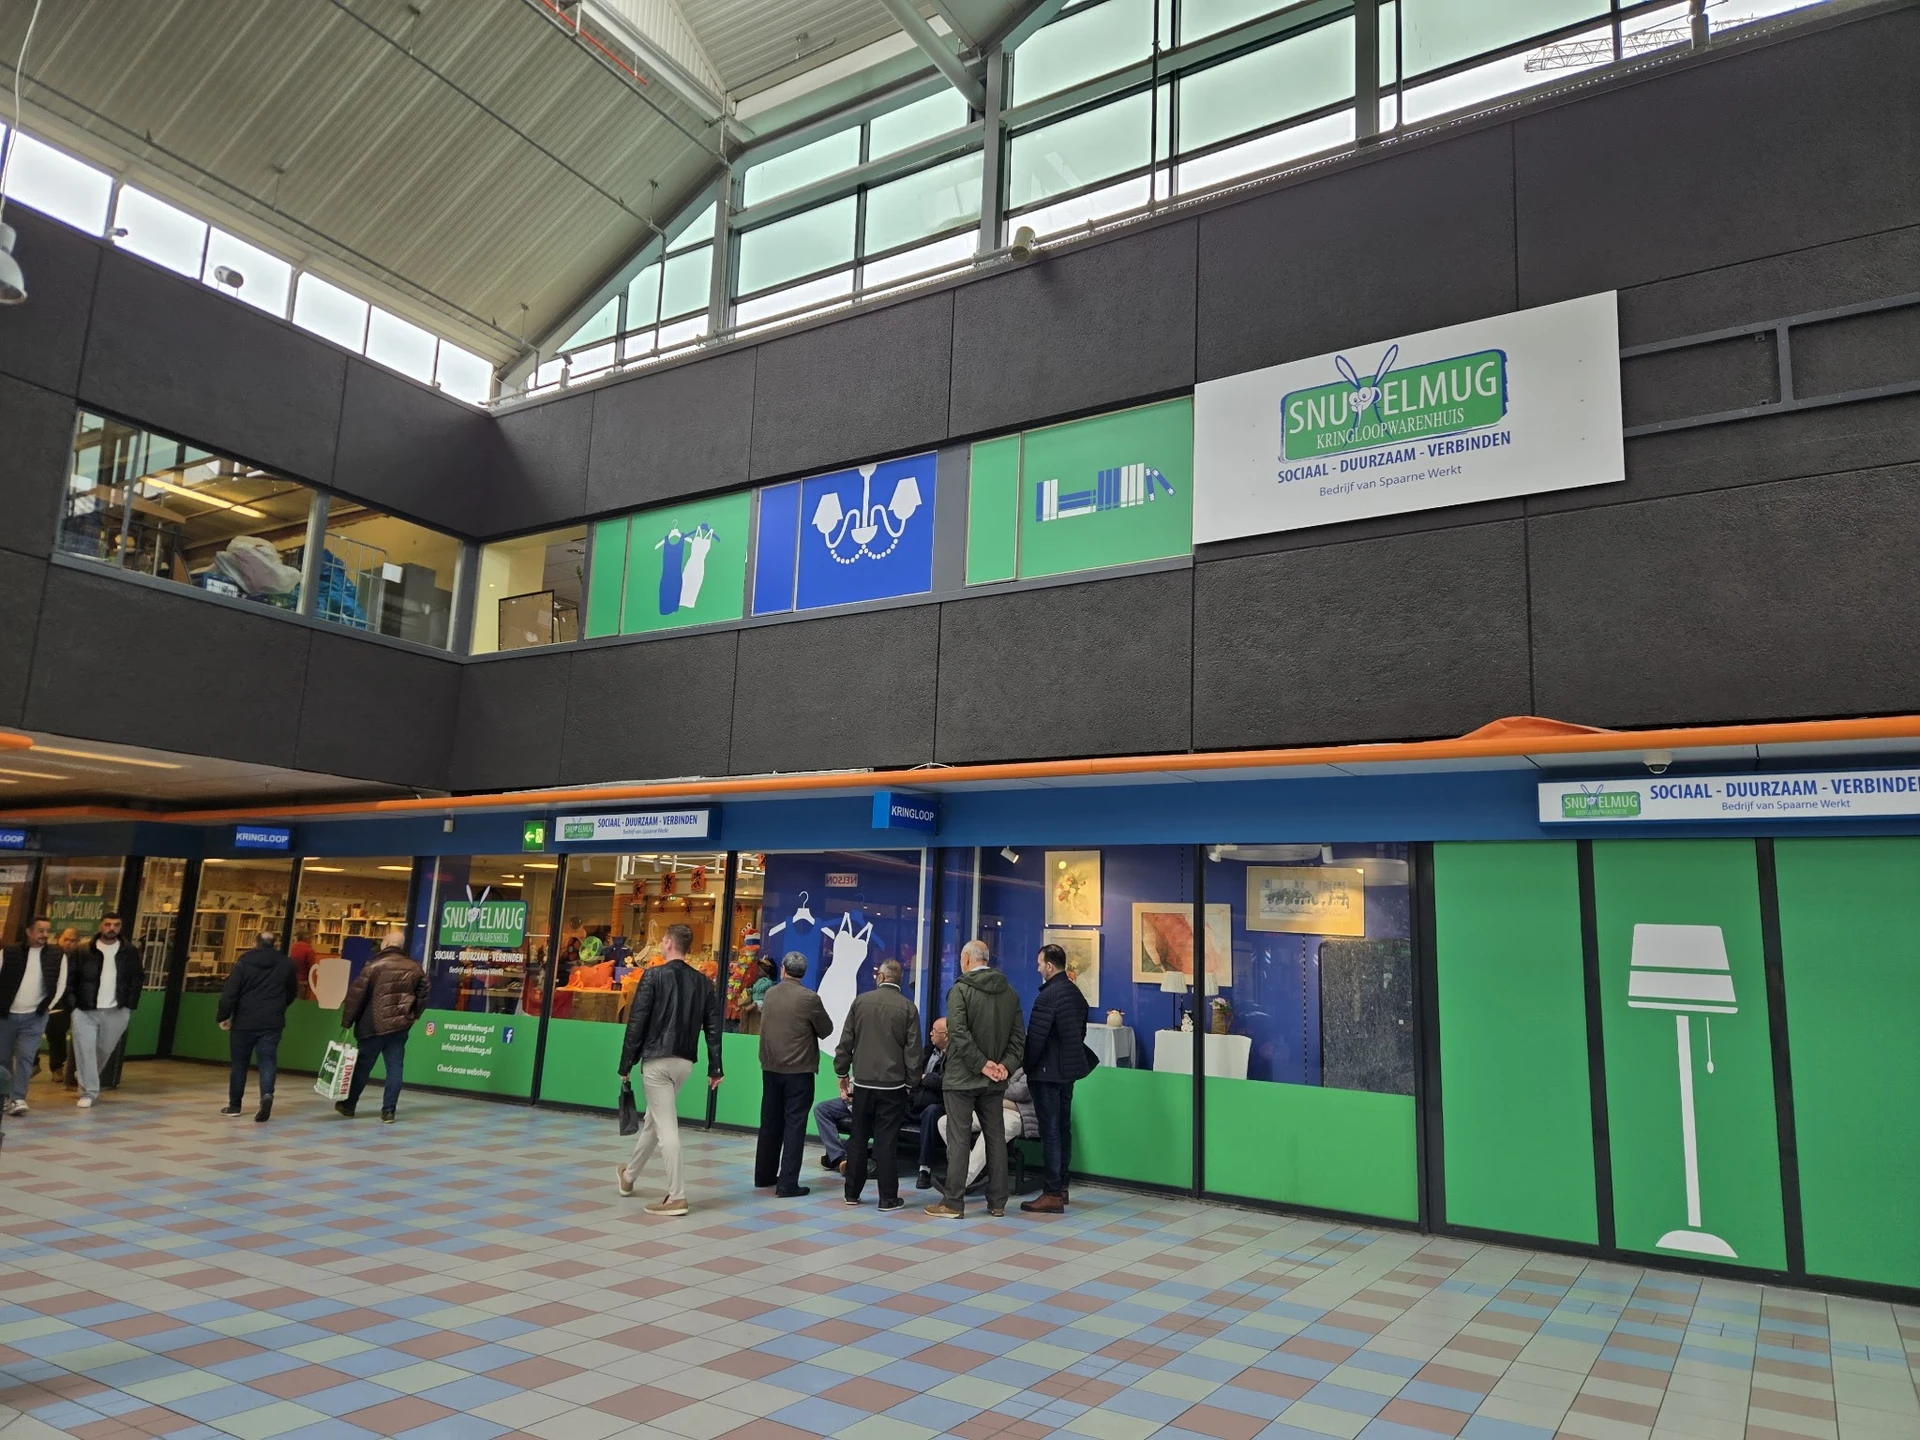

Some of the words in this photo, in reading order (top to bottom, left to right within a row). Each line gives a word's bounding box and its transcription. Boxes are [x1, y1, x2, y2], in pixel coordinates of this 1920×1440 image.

[1316, 407, 1465, 450] KRINGLOOPWARENHUIS
[1277, 461, 1329, 484] SOCIAAL
[1340, 448, 1417, 473] DUURZAAM
[1428, 431, 1512, 458] VERBINDEN
[1319, 481, 1355, 497] Bedrijf
[1357, 480, 1376, 491] van
[1379, 472, 1426, 490] Spaarne
[1428, 465, 1463, 479] Werkt
[1650, 783, 1713, 800] SOCIAAL
[1726, 779, 1818, 798] DUURZAAM
[1830, 776, 1920, 795] VERBINDE
[891, 805, 935, 822] KRINGLOOP
[1721, 801, 1754, 812] Bedrijf
[1776, 800, 1819, 812] Spaarne
[1820, 799, 1851, 808] Werkt
[597, 818, 621, 827] SOCIAAL
[625, 816, 659, 827] DUURZAAM
[662, 815, 698, 826] VERBINDEN
[236, 832, 289, 843] KRINGLOOP
[491, 952, 524, 963] VERBINDEN
[449, 1033, 460, 1041] 023
[460, 1034, 468, 1042] 54
[437, 1063, 453, 1073] Check
[453, 1067, 467, 1075] onze
[466, 1068, 491, 1079] webshop
[340, 1065, 352, 1094] DAGEN
